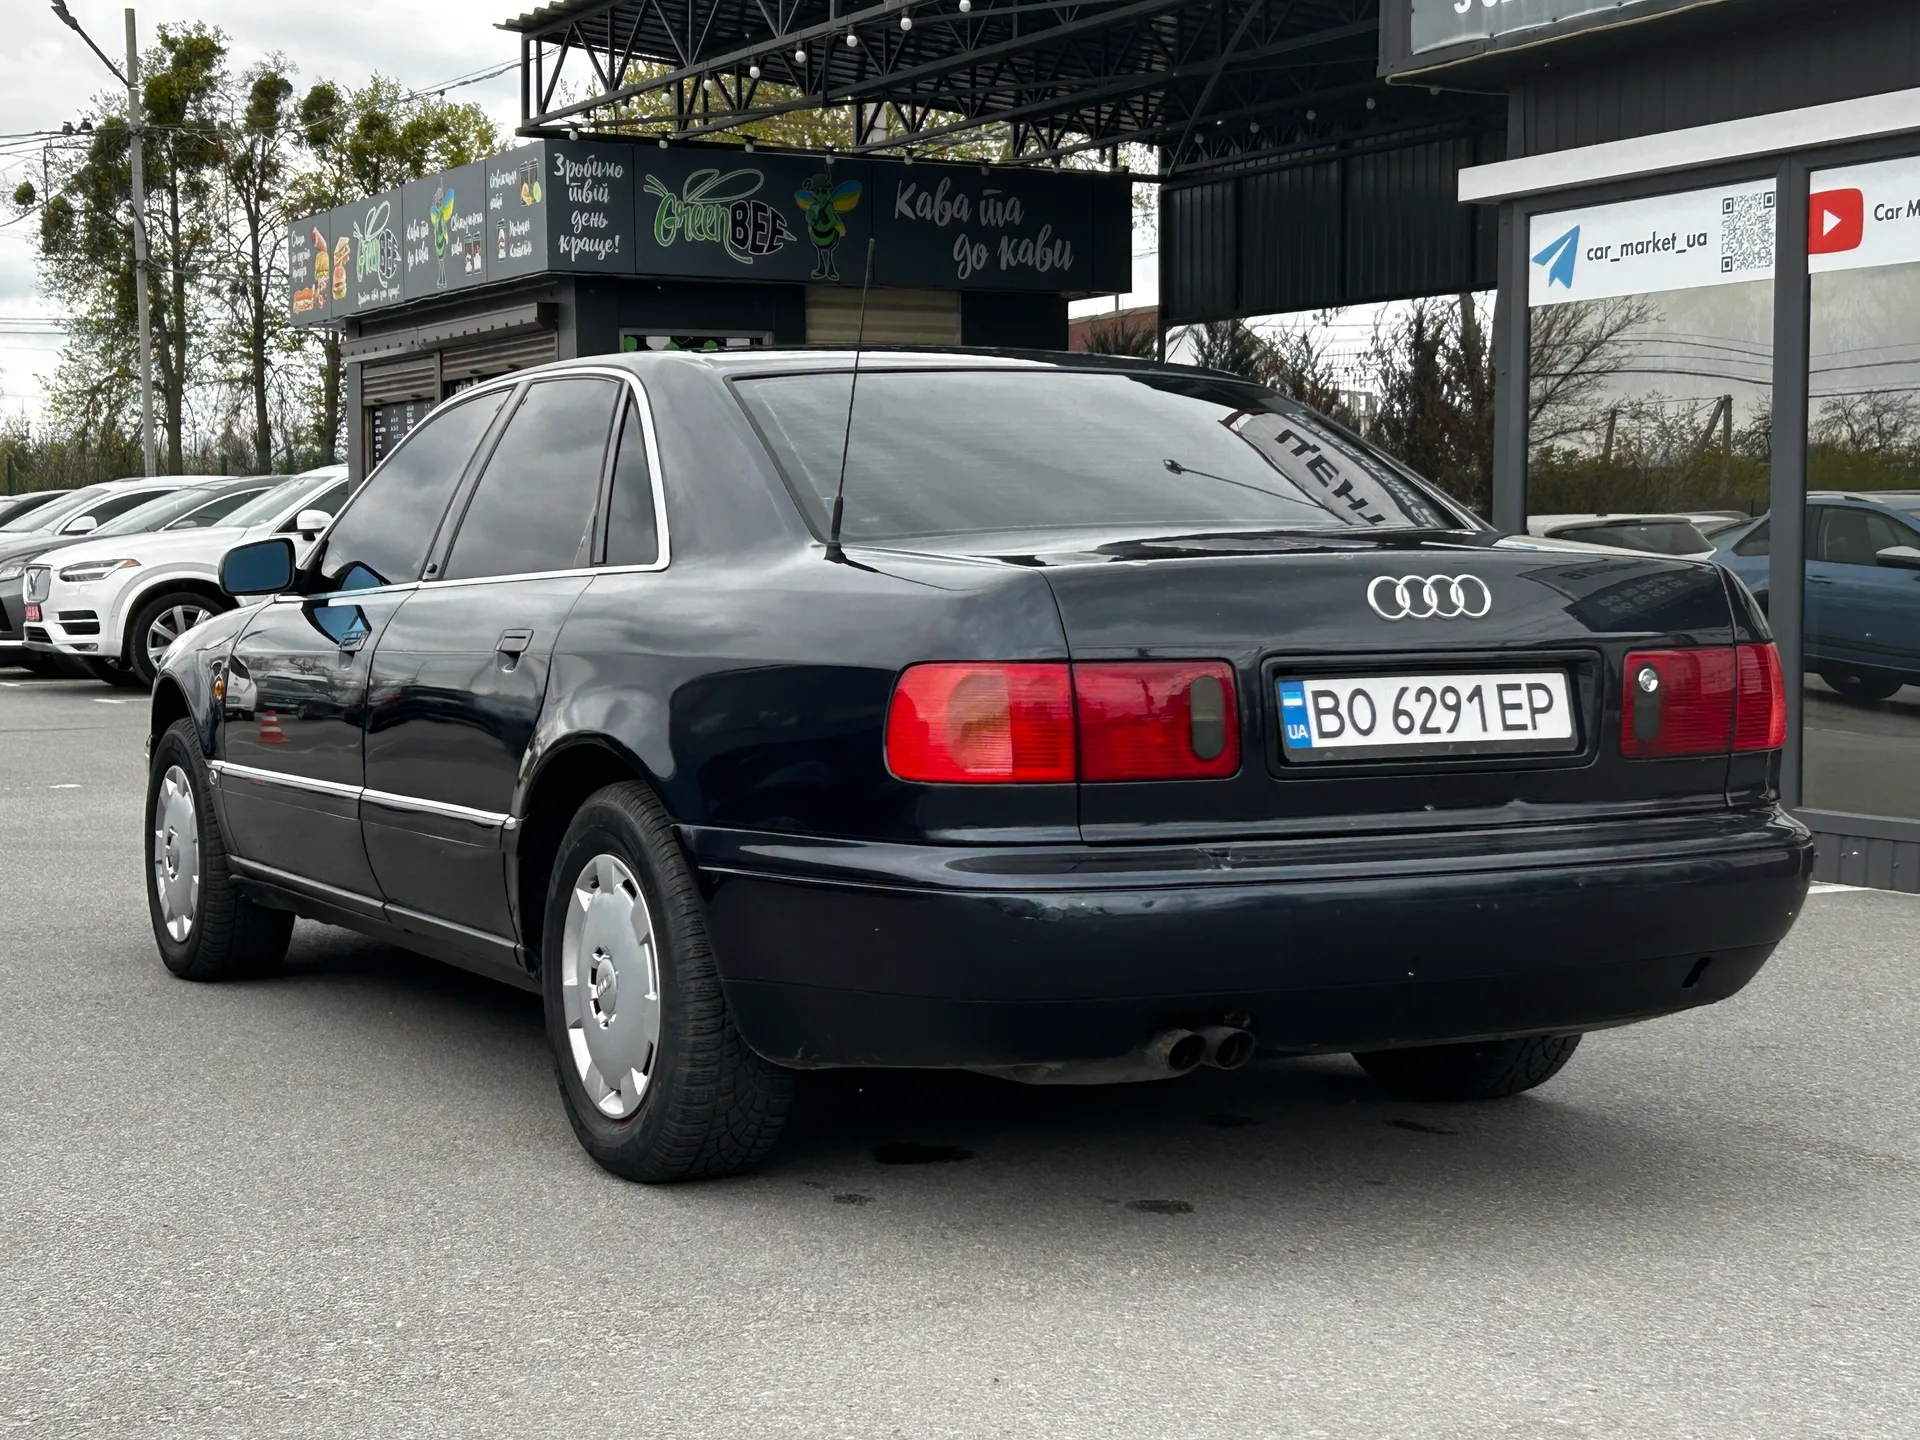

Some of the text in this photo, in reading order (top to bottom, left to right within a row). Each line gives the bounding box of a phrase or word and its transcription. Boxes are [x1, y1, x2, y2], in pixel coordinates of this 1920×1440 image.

[553, 153, 624, 185] Зробимо
[569, 179, 610, 204] твій
[895, 176, 1024, 227] Кава та
[571, 210, 609, 234] день
[1873, 203, 1904, 222] Car
[558, 235, 620, 262] краще!
[953, 223, 1074, 280] до кави
[1586, 231, 1708, 263] car_market_ua
[1311, 683, 1554, 739] BO 6291 EP
[1287, 723, 1309, 740] UA
